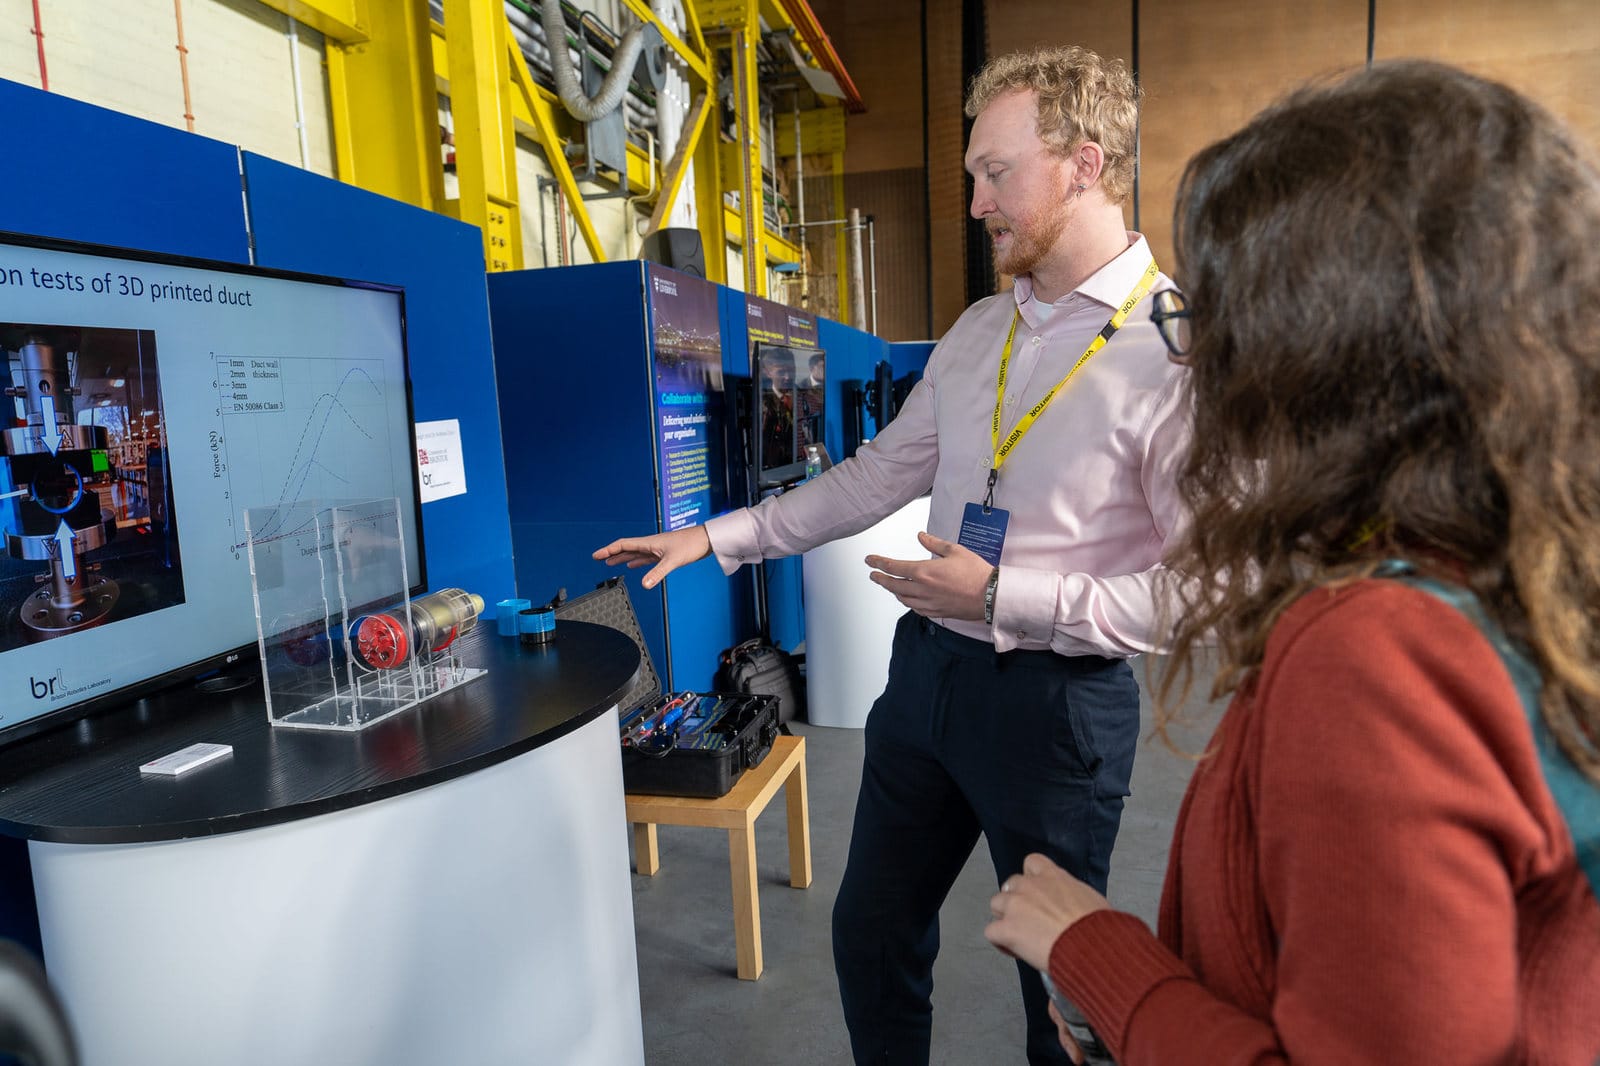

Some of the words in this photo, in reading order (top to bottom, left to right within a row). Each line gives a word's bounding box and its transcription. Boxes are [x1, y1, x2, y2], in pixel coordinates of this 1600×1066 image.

[30, 267, 84, 292] tests
[91, 272, 111, 294] of
[118, 275, 143, 296] 3D
[150, 281, 212, 303] printed
[218, 285, 252, 306] duct
[229, 358, 245, 367] 1mm
[251, 360, 265, 369] Duct
[266, 360, 279, 369] wall
[230, 370, 246, 378] 2mm
[252, 370, 279, 379] thickness
[212, 380, 218, 389] 6
[231, 381, 247, 389] 3mm
[232, 392, 248, 401] 4mm
[233, 403, 244, 412] EN
[263, 401, 279, 410] Class
[1029, 390, 1055, 417] VISITOR
[215, 408, 220, 417] 5
[209, 430, 219, 452] (kN)
[999, 429, 1022, 457] VISITOR
[213, 453, 221, 478] Force
[224, 491, 230, 499] 2
